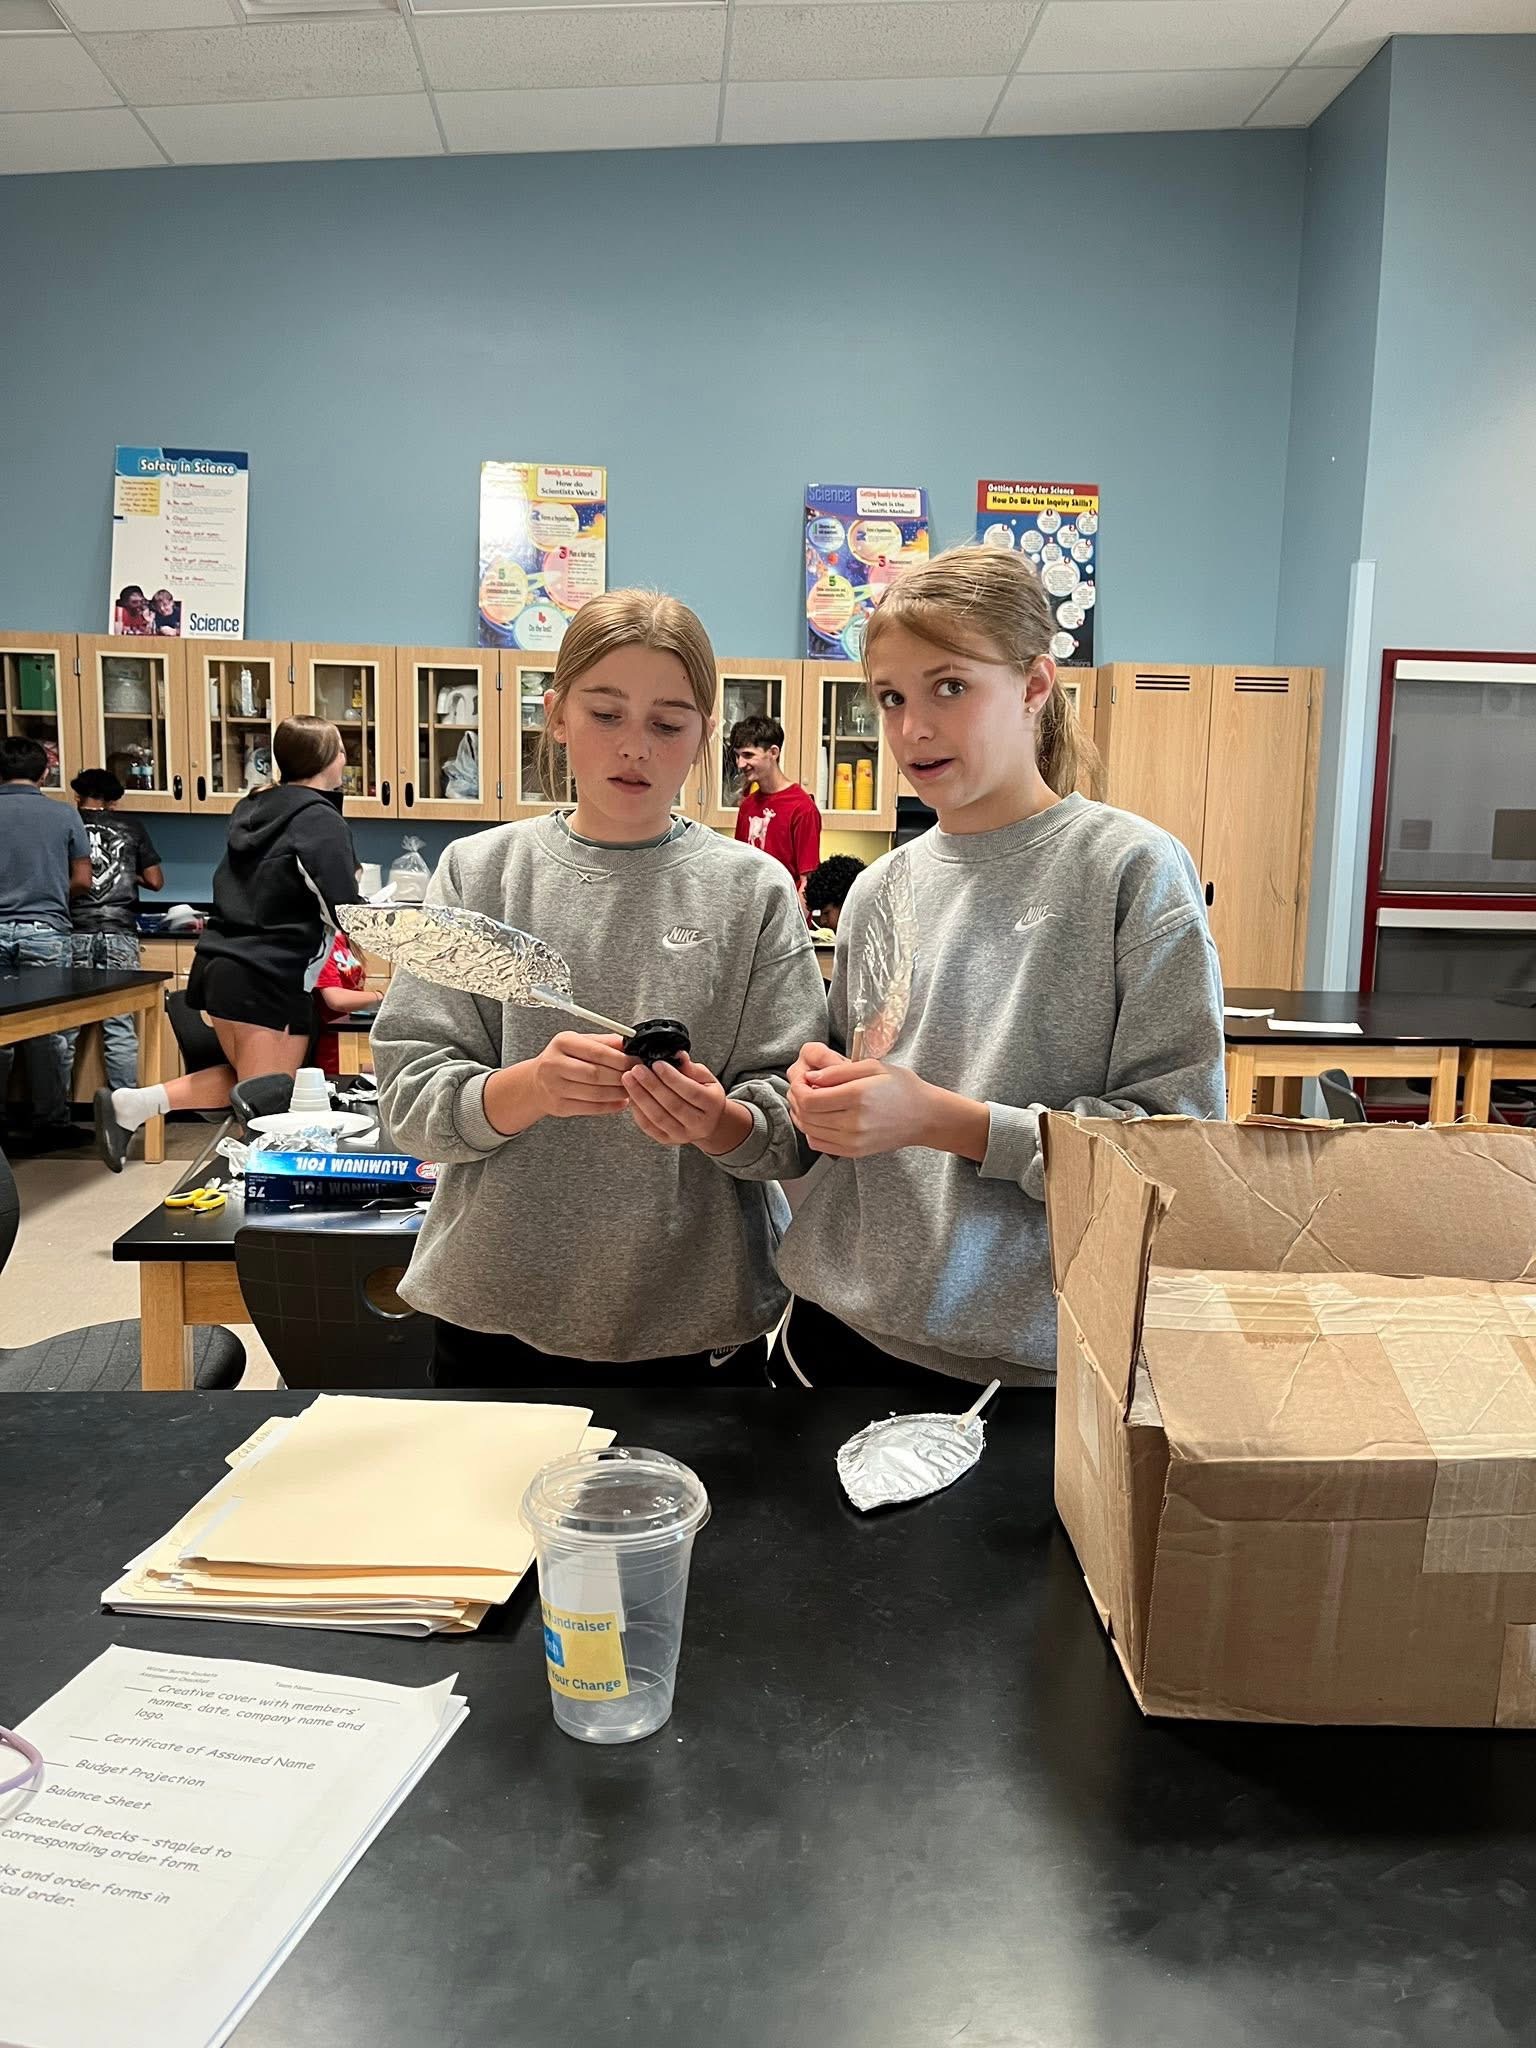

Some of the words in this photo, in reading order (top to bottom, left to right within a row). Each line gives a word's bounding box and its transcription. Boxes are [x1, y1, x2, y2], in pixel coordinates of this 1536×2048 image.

[140, 459, 177, 475] Safety
[180, 460, 191, 472] in
[194, 461, 234, 474] Science
[541, 488, 574, 496] Scientists
[808, 487, 851, 502] Science
[987, 483, 1014, 495] Getting
[1015, 484, 1037, 496] Ready
[1050, 486, 1074, 495] Science
[992, 496, 1007, 504] How
[1009, 496, 1018, 504] Do
[1020, 497, 1031, 505] We
[1033, 497, 1045, 505] Use
[1046, 498, 1070, 508] Inquiry
[1071, 499, 1093, 507] Skills?
[856, 530, 866, 541] 2
[558, 546, 567, 559] 3
[878, 555, 886, 567] 3
[829, 575, 836, 587] 5
[189, 612, 240, 633] Science
[668, 926, 700, 943] NIKE
[295, 1157, 327, 1172] FOIL
[331, 1157, 409, 1175] ALUMINUM
[248, 1186, 266, 1198] 75
[572, 1679, 622, 1693] Change
[158, 1684, 216, 1700] Creative
[217, 1691, 257, 1703] cover
[259, 1697, 290, 1709] with
[134, 1707, 165, 1721] logo.
[148, 1697, 193, 1712] names,
[197, 1702, 231, 1718] date,
[236, 1710, 296, 1725] company
[297, 1716, 335, 1727] name
[336, 1722, 366, 1732] and
[104, 1733, 184, 1752] Certificate
[185, 1745, 205, 1756] of
[206, 1748, 273, 1766] Assumed
[273, 1756, 316, 1771] Name
[75, 1758, 128, 1775] Budget
[129, 1767, 206, 1788] Projection
[45, 1784, 102, 1802] Balance
[103, 1794, 152, 1811] Sheet
[14, 1811, 85, 1833] Canceled
[83, 1825, 139, 1843] Checks
[151, 1837, 215, 1856] stapled
[215, 1847, 232, 1859] to
[1, 1828, 109, 1858] corresponding
[110, 1845, 157, 1865] order
[161, 1855, 200, 1873] form.
[21, 1869, 55, 1883] and
[53, 1876, 101, 1892] order
[102, 1882, 153, 1901] forms
[154, 1891, 171, 1905] in
[27, 1889, 75, 1908] order.
